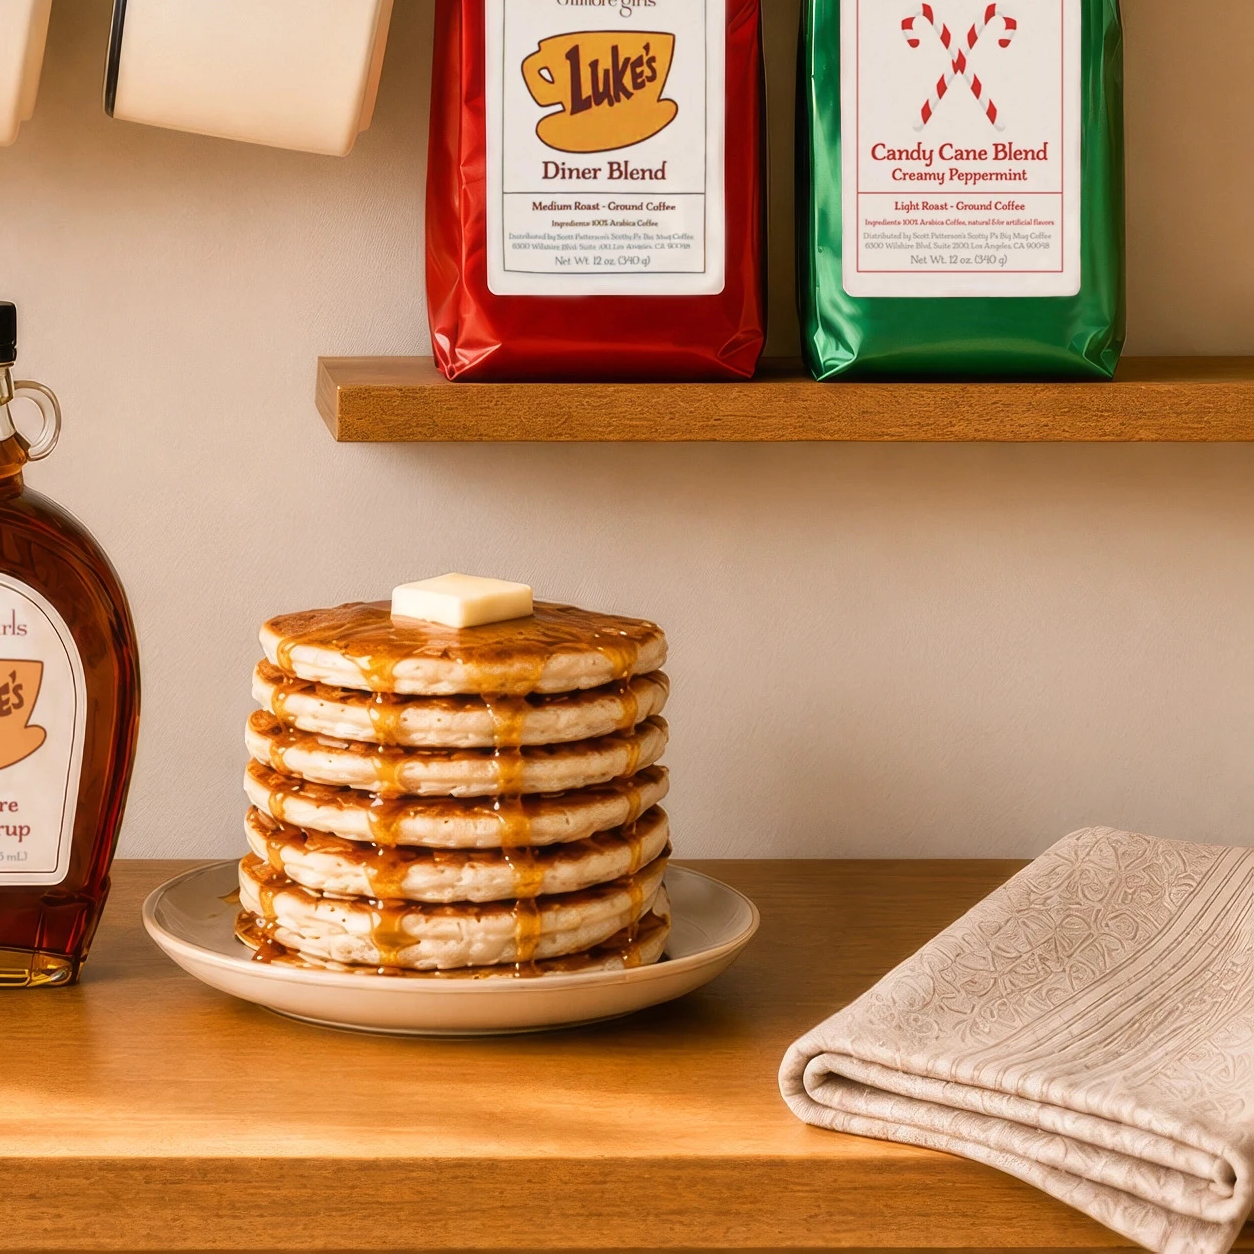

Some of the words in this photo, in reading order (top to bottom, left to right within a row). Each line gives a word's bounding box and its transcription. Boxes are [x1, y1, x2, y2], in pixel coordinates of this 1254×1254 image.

[871, 142, 934, 167] Candy
[939, 143, 987, 160] Cane
[992, 142, 1048, 160] Blend
[542, 161, 601, 179] Diner
[607, 160, 667, 180] Blend
[892, 168, 945, 185] Creamy
[949, 168, 1027, 185] Peppermint
[532, 201, 572, 211] Medium
[574, 202, 600, 210] Roast
[608, 202, 643, 210] Ground
[646, 202, 675, 211] Coffee
[895, 201, 920, 213] Light
[922, 201, 948, 210] Roast
[956, 201, 992, 210] Ground
[994, 201, 1025, 210] Coffee
[7, 851, 27, 861] mL)
